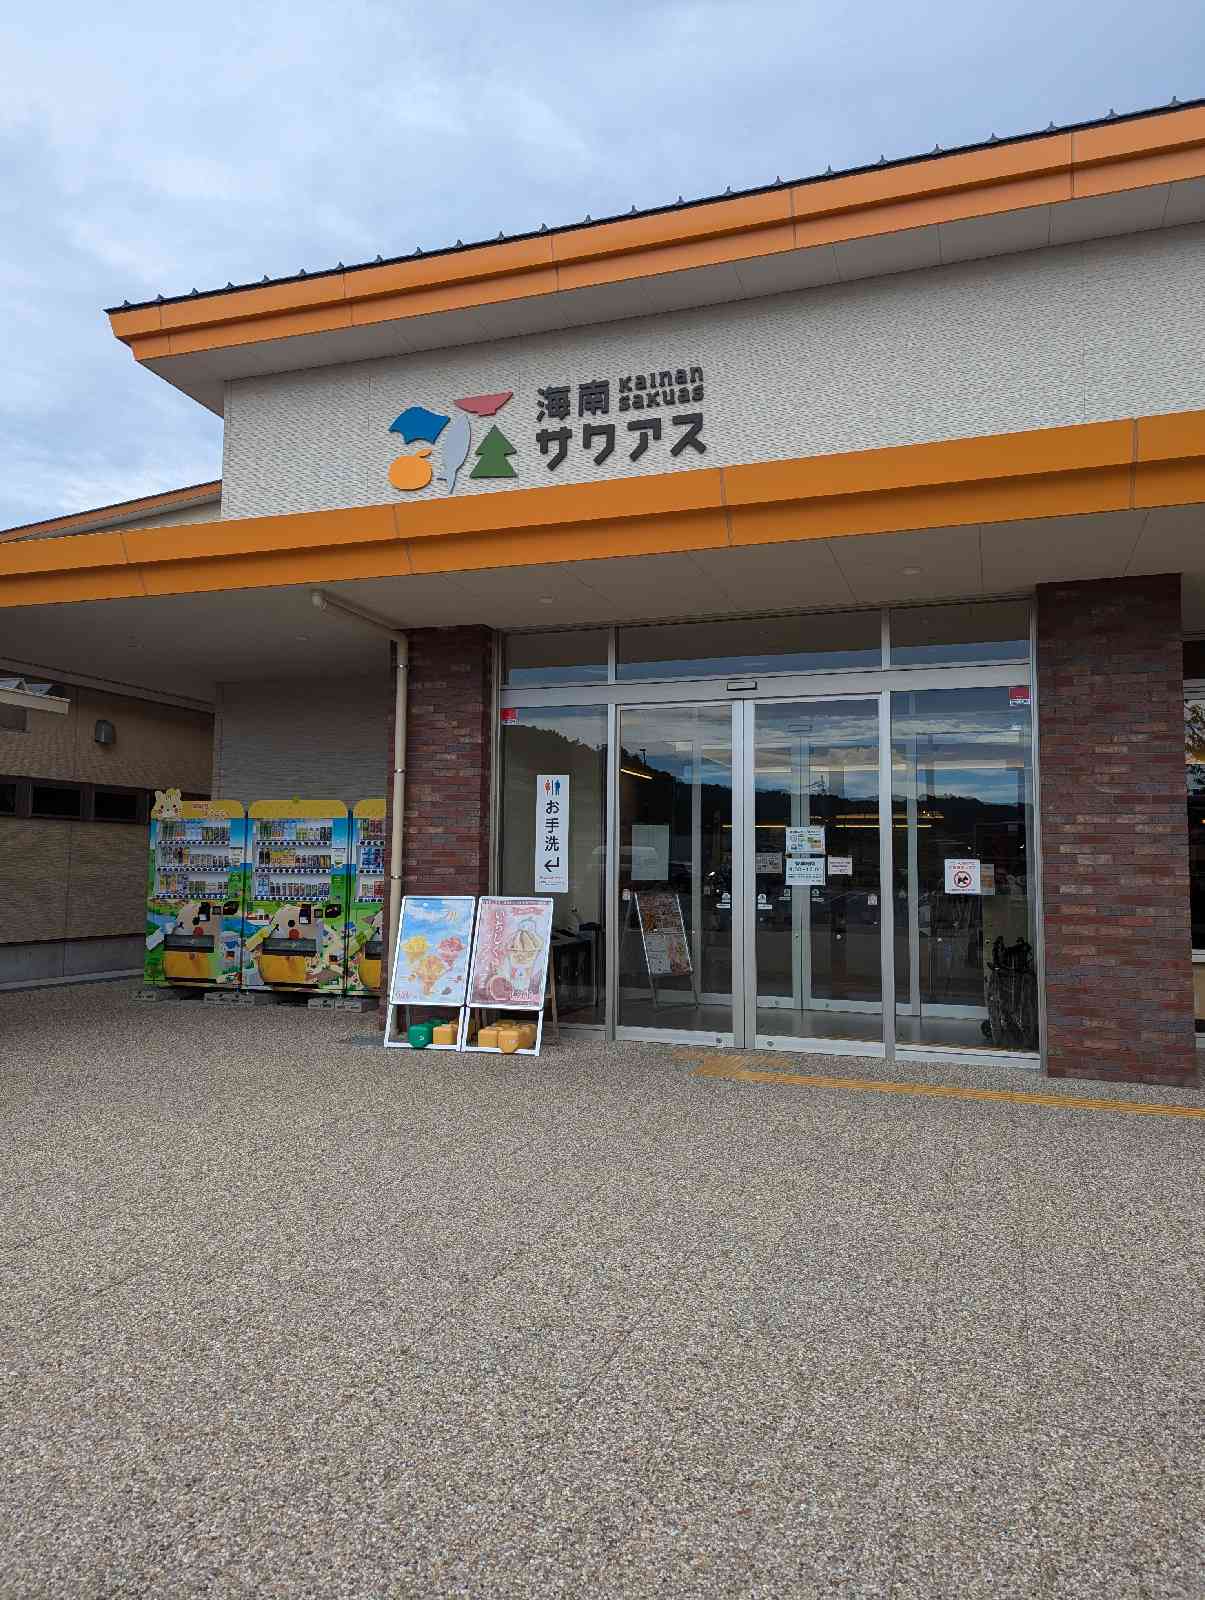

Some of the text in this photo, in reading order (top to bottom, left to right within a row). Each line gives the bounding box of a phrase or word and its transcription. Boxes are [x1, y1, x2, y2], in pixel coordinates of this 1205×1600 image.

[536, 379, 610, 421] 海南
[536, 412, 707, 471] サクアス
[544, 800, 560, 852] お手洗
